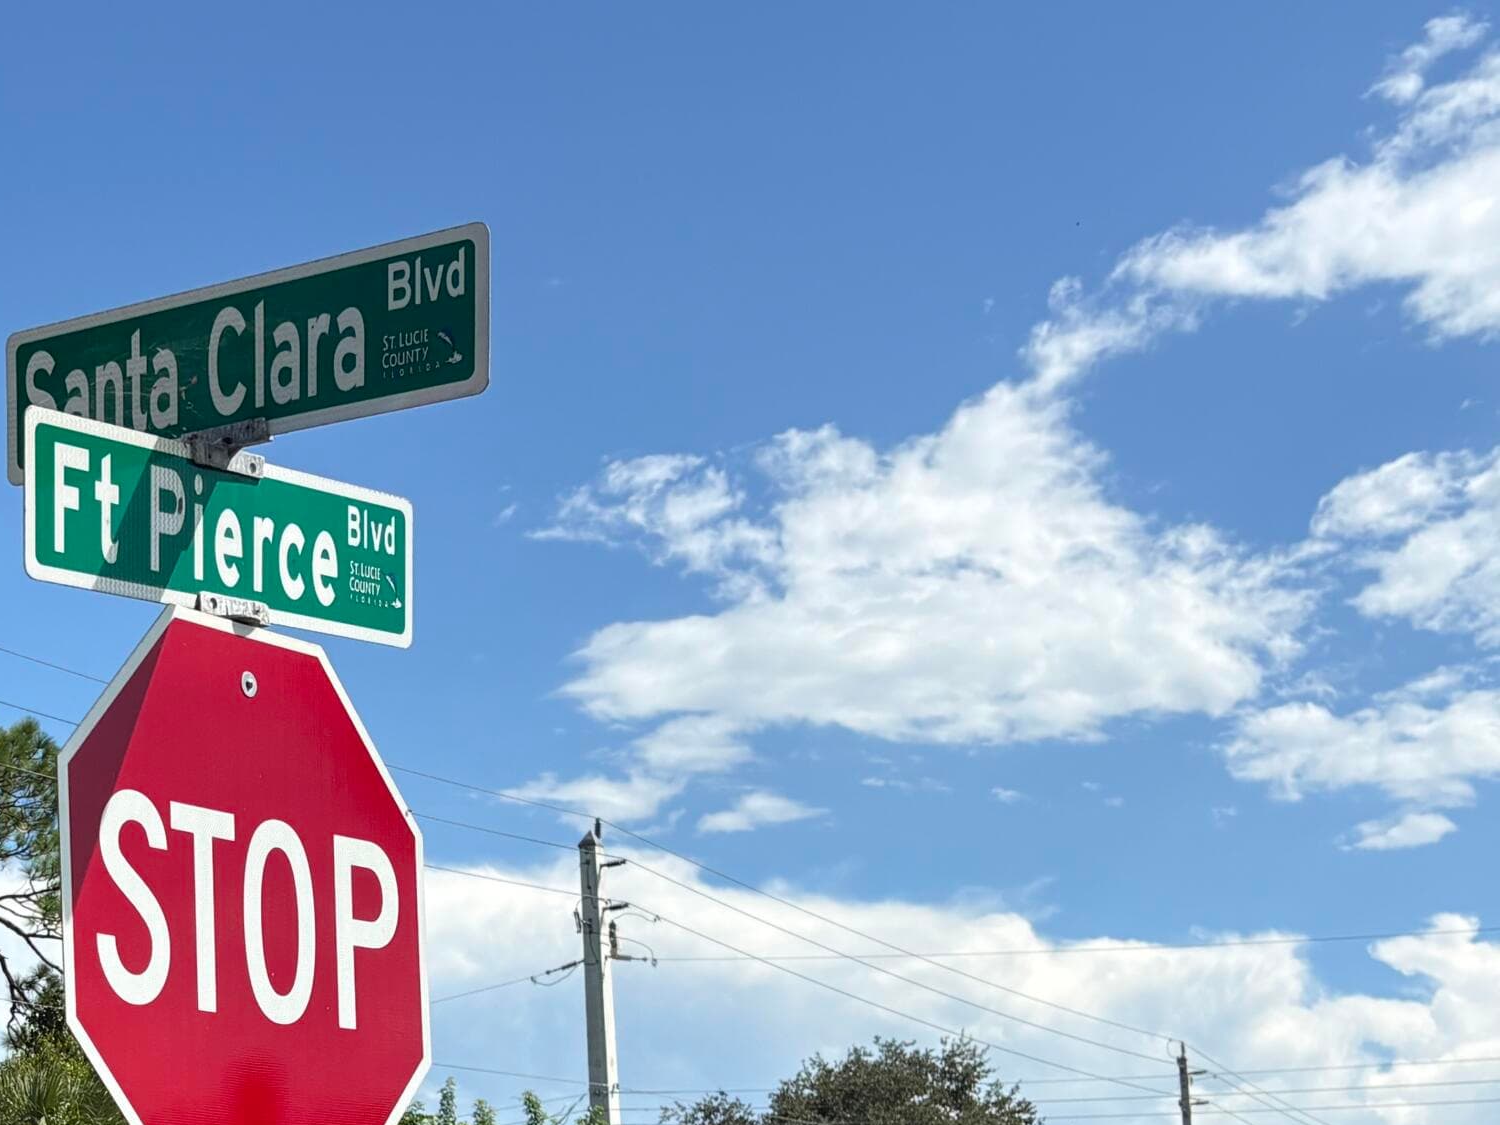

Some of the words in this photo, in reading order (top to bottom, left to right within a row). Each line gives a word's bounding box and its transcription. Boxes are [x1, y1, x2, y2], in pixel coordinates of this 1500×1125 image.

[25, 328, 179, 433] Santa
[208, 300, 366, 416] Clara
[387, 247, 465, 311] Blvd
[382, 335, 397, 352] ST.
[399, 328, 429, 348] LUCIE
[382, 346, 429, 369] COUNTY
[54, 441, 119, 564] Ft
[150, 464, 339, 607] Pierce
[347, 505, 396, 556] Blvd
[360, 562, 381, 581] LUCIE
[349, 576, 381, 596] COUNTY
[96, 789, 399, 1030] STOP
